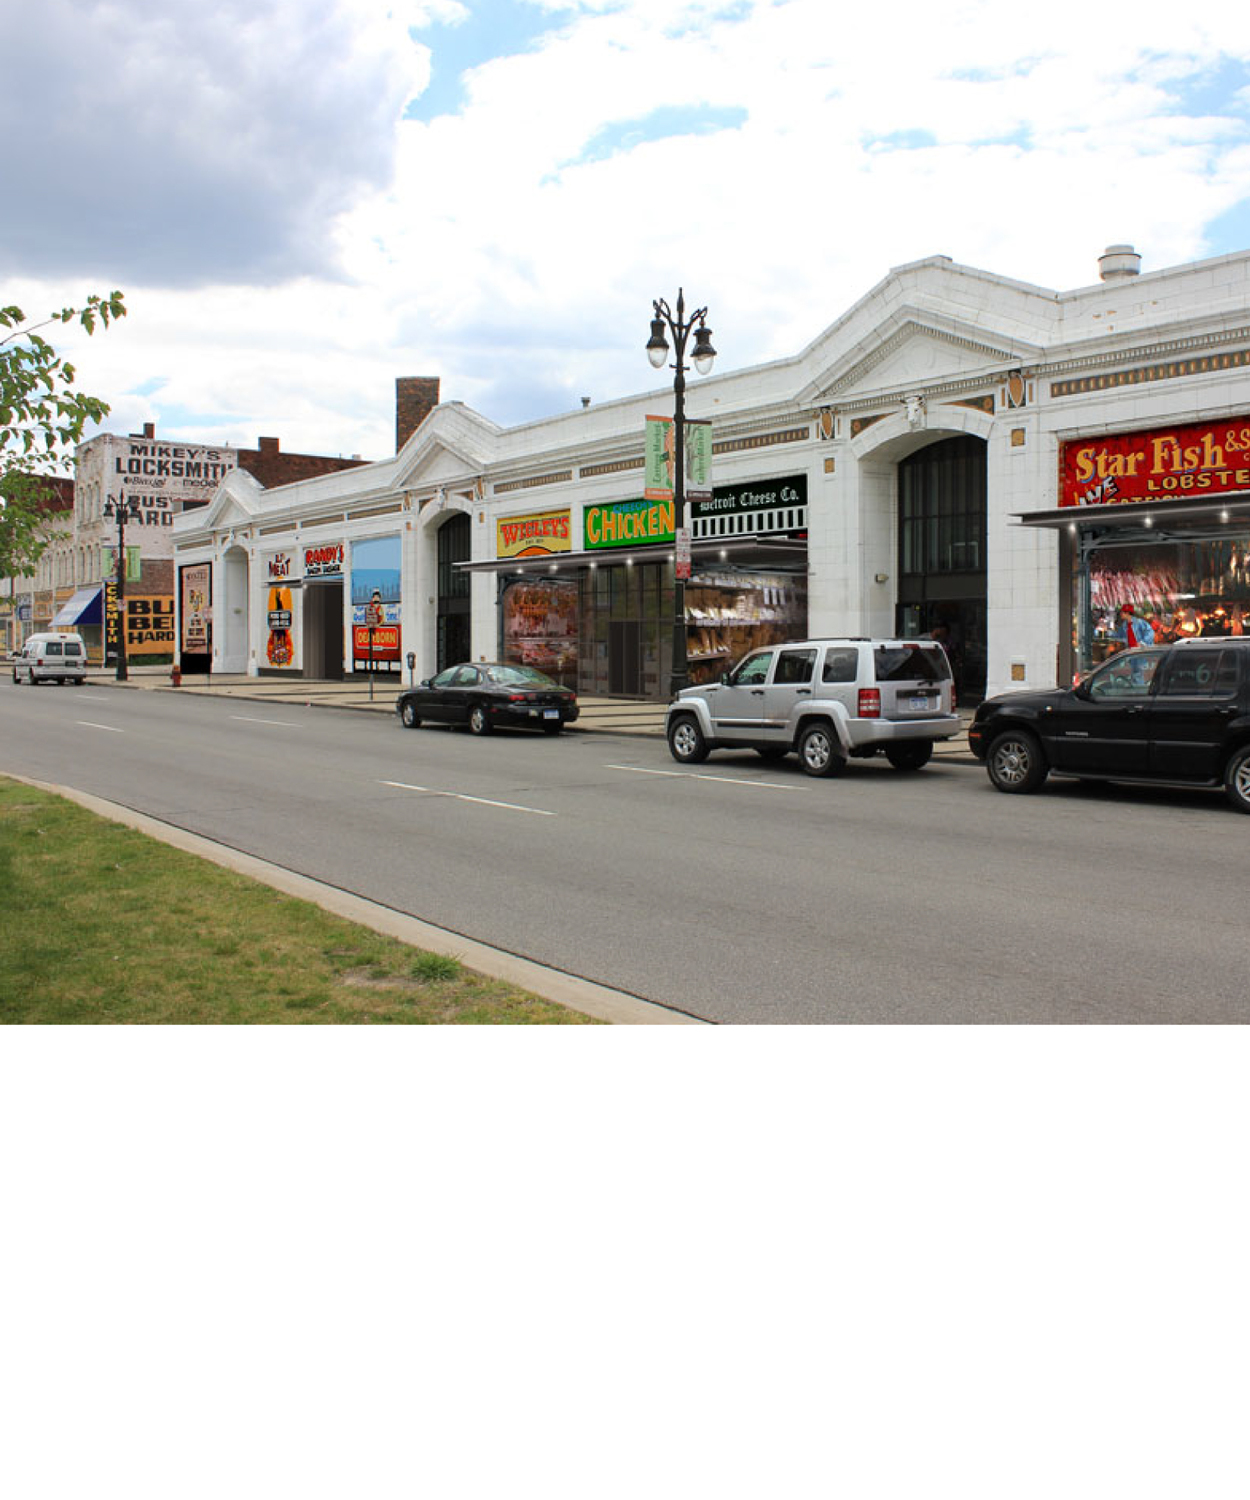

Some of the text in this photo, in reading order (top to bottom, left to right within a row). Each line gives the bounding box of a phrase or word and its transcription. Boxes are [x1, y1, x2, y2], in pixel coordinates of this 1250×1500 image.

[130, 444, 222, 460] MIKEY'S
[1075, 432, 1228, 483] Star Fish
[740, 490, 777, 506] Cheese
[780, 486, 800, 502] Co.
[587, 502, 675, 544] CHICKEN
[305, 544, 344, 567] RANDY'S
